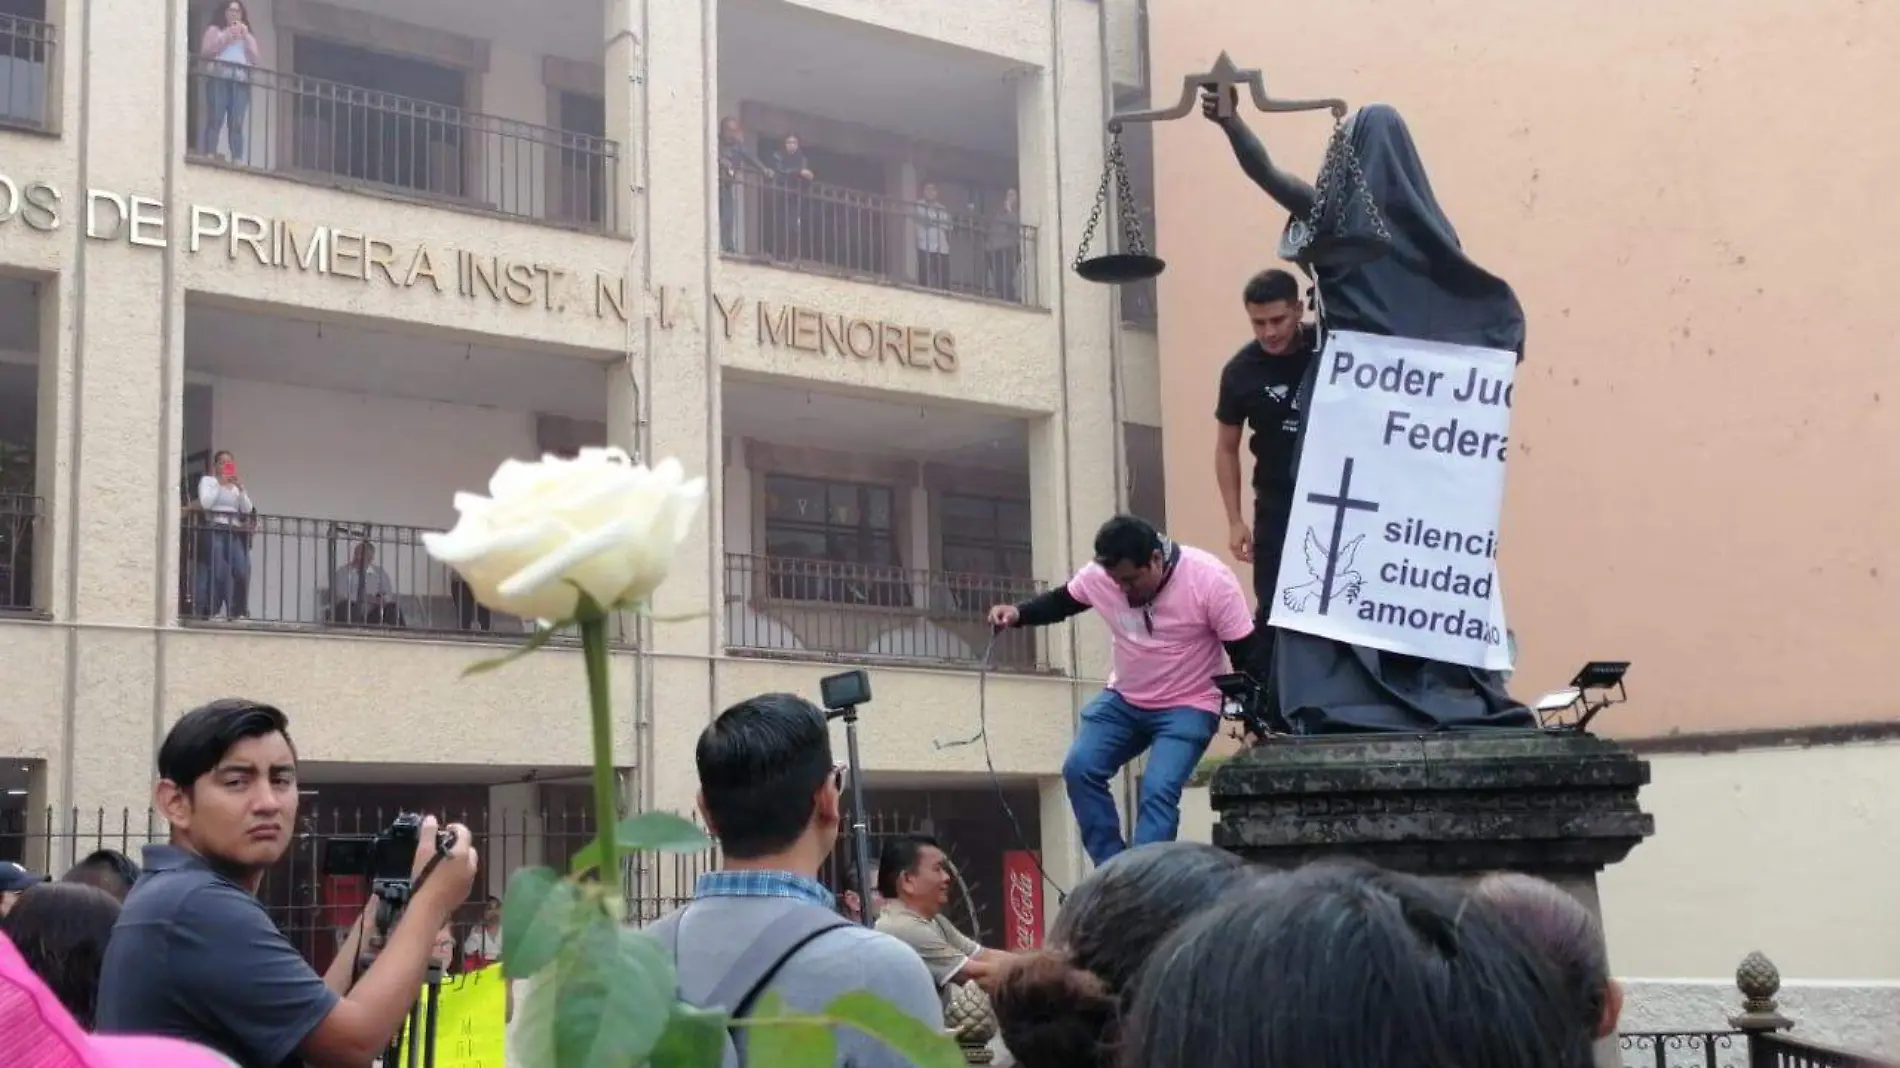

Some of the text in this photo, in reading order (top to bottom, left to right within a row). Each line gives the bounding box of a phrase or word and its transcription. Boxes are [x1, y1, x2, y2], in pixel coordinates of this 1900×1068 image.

[85, 188, 167, 248] DE
[189, 204, 443, 293] PRIMERA
[713, 292, 744, 341] Y
[756, 300, 961, 374] MENORES
[1329, 351, 1444, 398] Poder
[1383, 517, 1498, 561] silenci
[1380, 557, 1493, 601] ciudad
